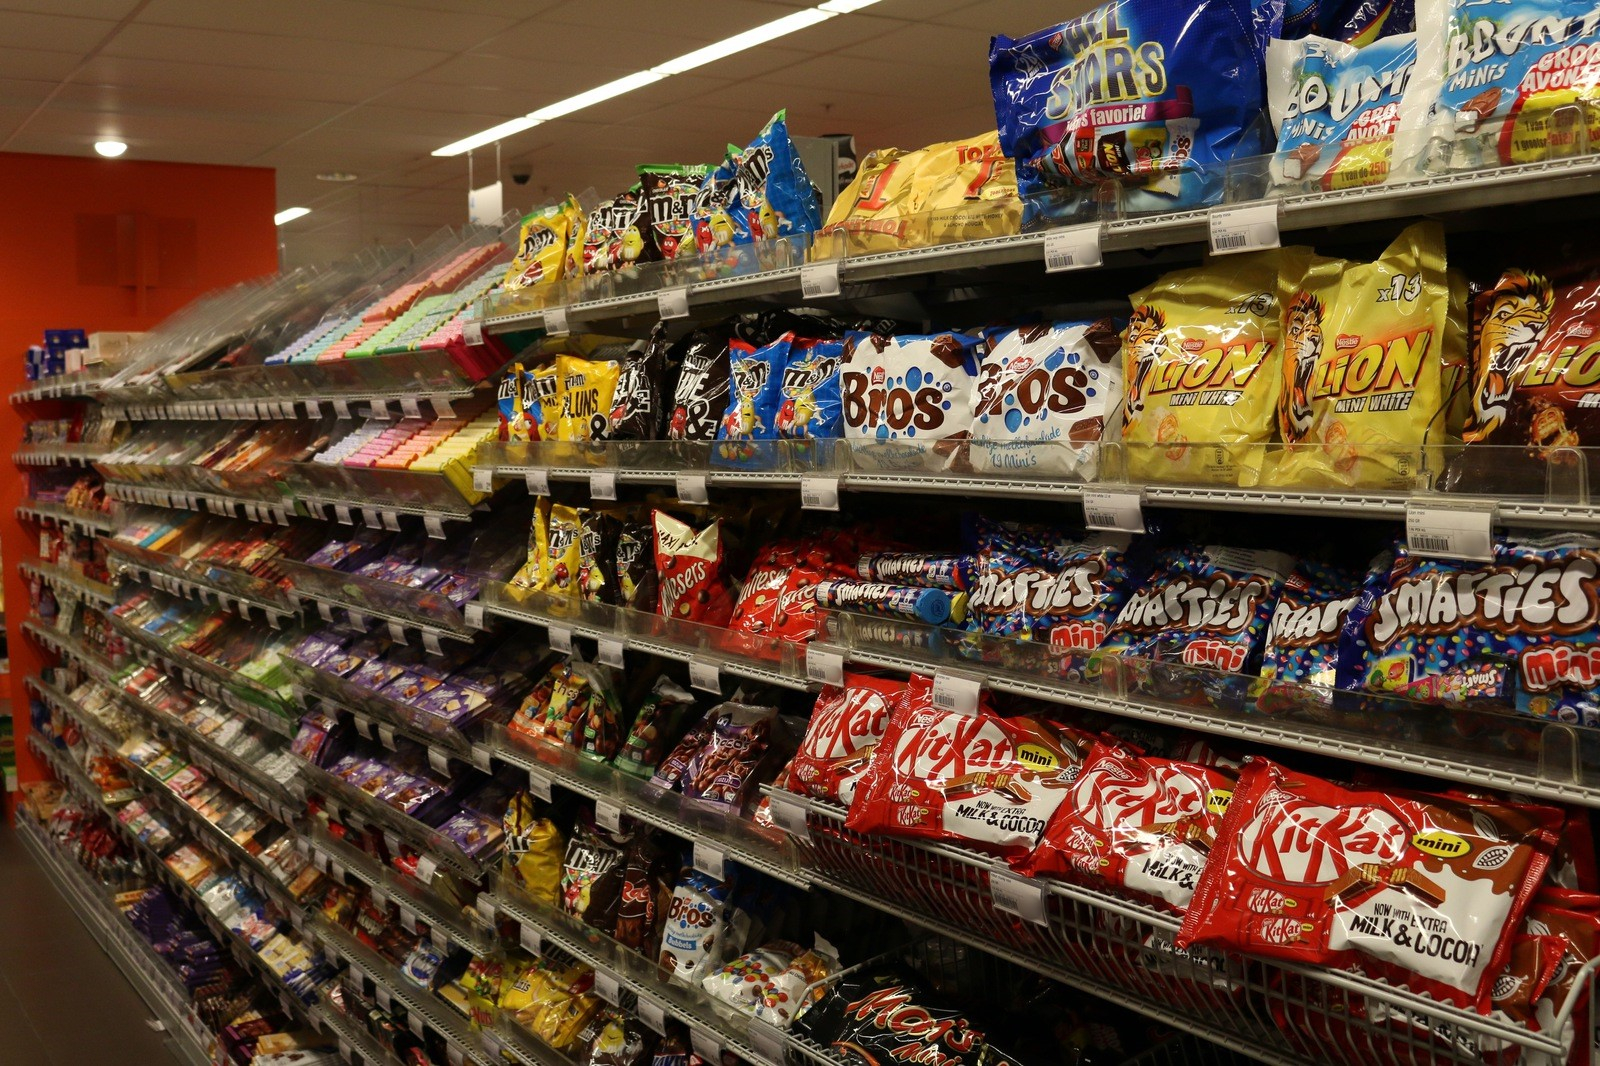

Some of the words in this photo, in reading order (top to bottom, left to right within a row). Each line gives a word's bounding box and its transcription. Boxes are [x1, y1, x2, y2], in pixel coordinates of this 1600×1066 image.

[1063, 1, 1130, 54] ALL
[1090, 104, 1148, 127] favoriet
[1370, 161, 1386, 177] 250
[1170, 391, 1198, 406] MINI
[1335, 395, 1366, 413] MINI
[1368, 391, 1414, 412] WHITE
[1374, 559, 1598, 642] SMARTIES
[895, 715, 1014, 778] KitKat
[1021, 747, 1053, 768] mini
[955, 803, 987, 821] MILK
[999, 813, 1046, 836] COCOA
[1416, 837, 1462, 853] mini
[1263, 918, 1301, 943] KitKat
[1374, 902, 1392, 917] NOW
[1392, 908, 1411, 921] WITH
[1410, 913, 1448, 934] EXTRA
[1350, 914, 1392, 940] MILK
[1393, 923, 1412, 947] &
[1414, 934, 1480, 968] COCOA
